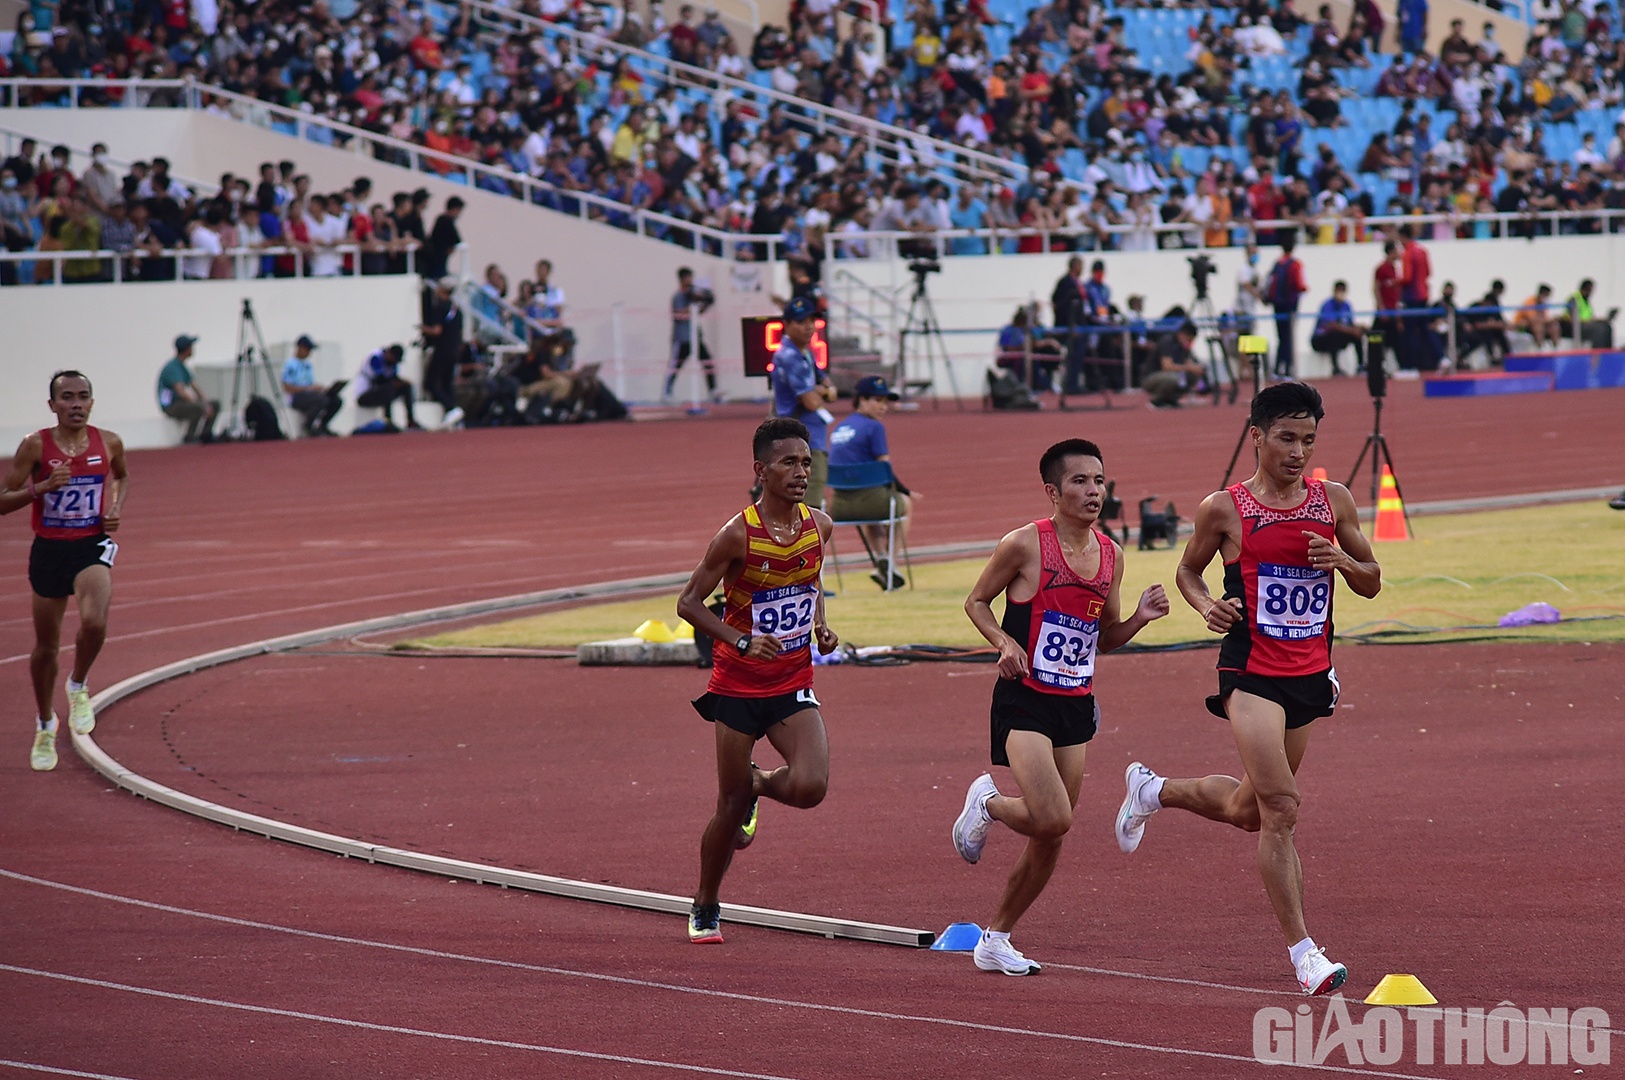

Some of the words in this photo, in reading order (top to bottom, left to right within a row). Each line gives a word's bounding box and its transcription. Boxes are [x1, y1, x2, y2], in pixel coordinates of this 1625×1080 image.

[49, 489, 95, 511] 721
[1287, 568, 1300, 577] SEA
[1302, 569, 1324, 578] Games
[778, 586, 789, 598] SEA
[1265, 583, 1328, 616] 808
[758, 598, 812, 633] 952
[1069, 617, 1082, 629] SEA
[1263, 626, 1283, 637] HANOI
[1042, 632, 1093, 666] 832
